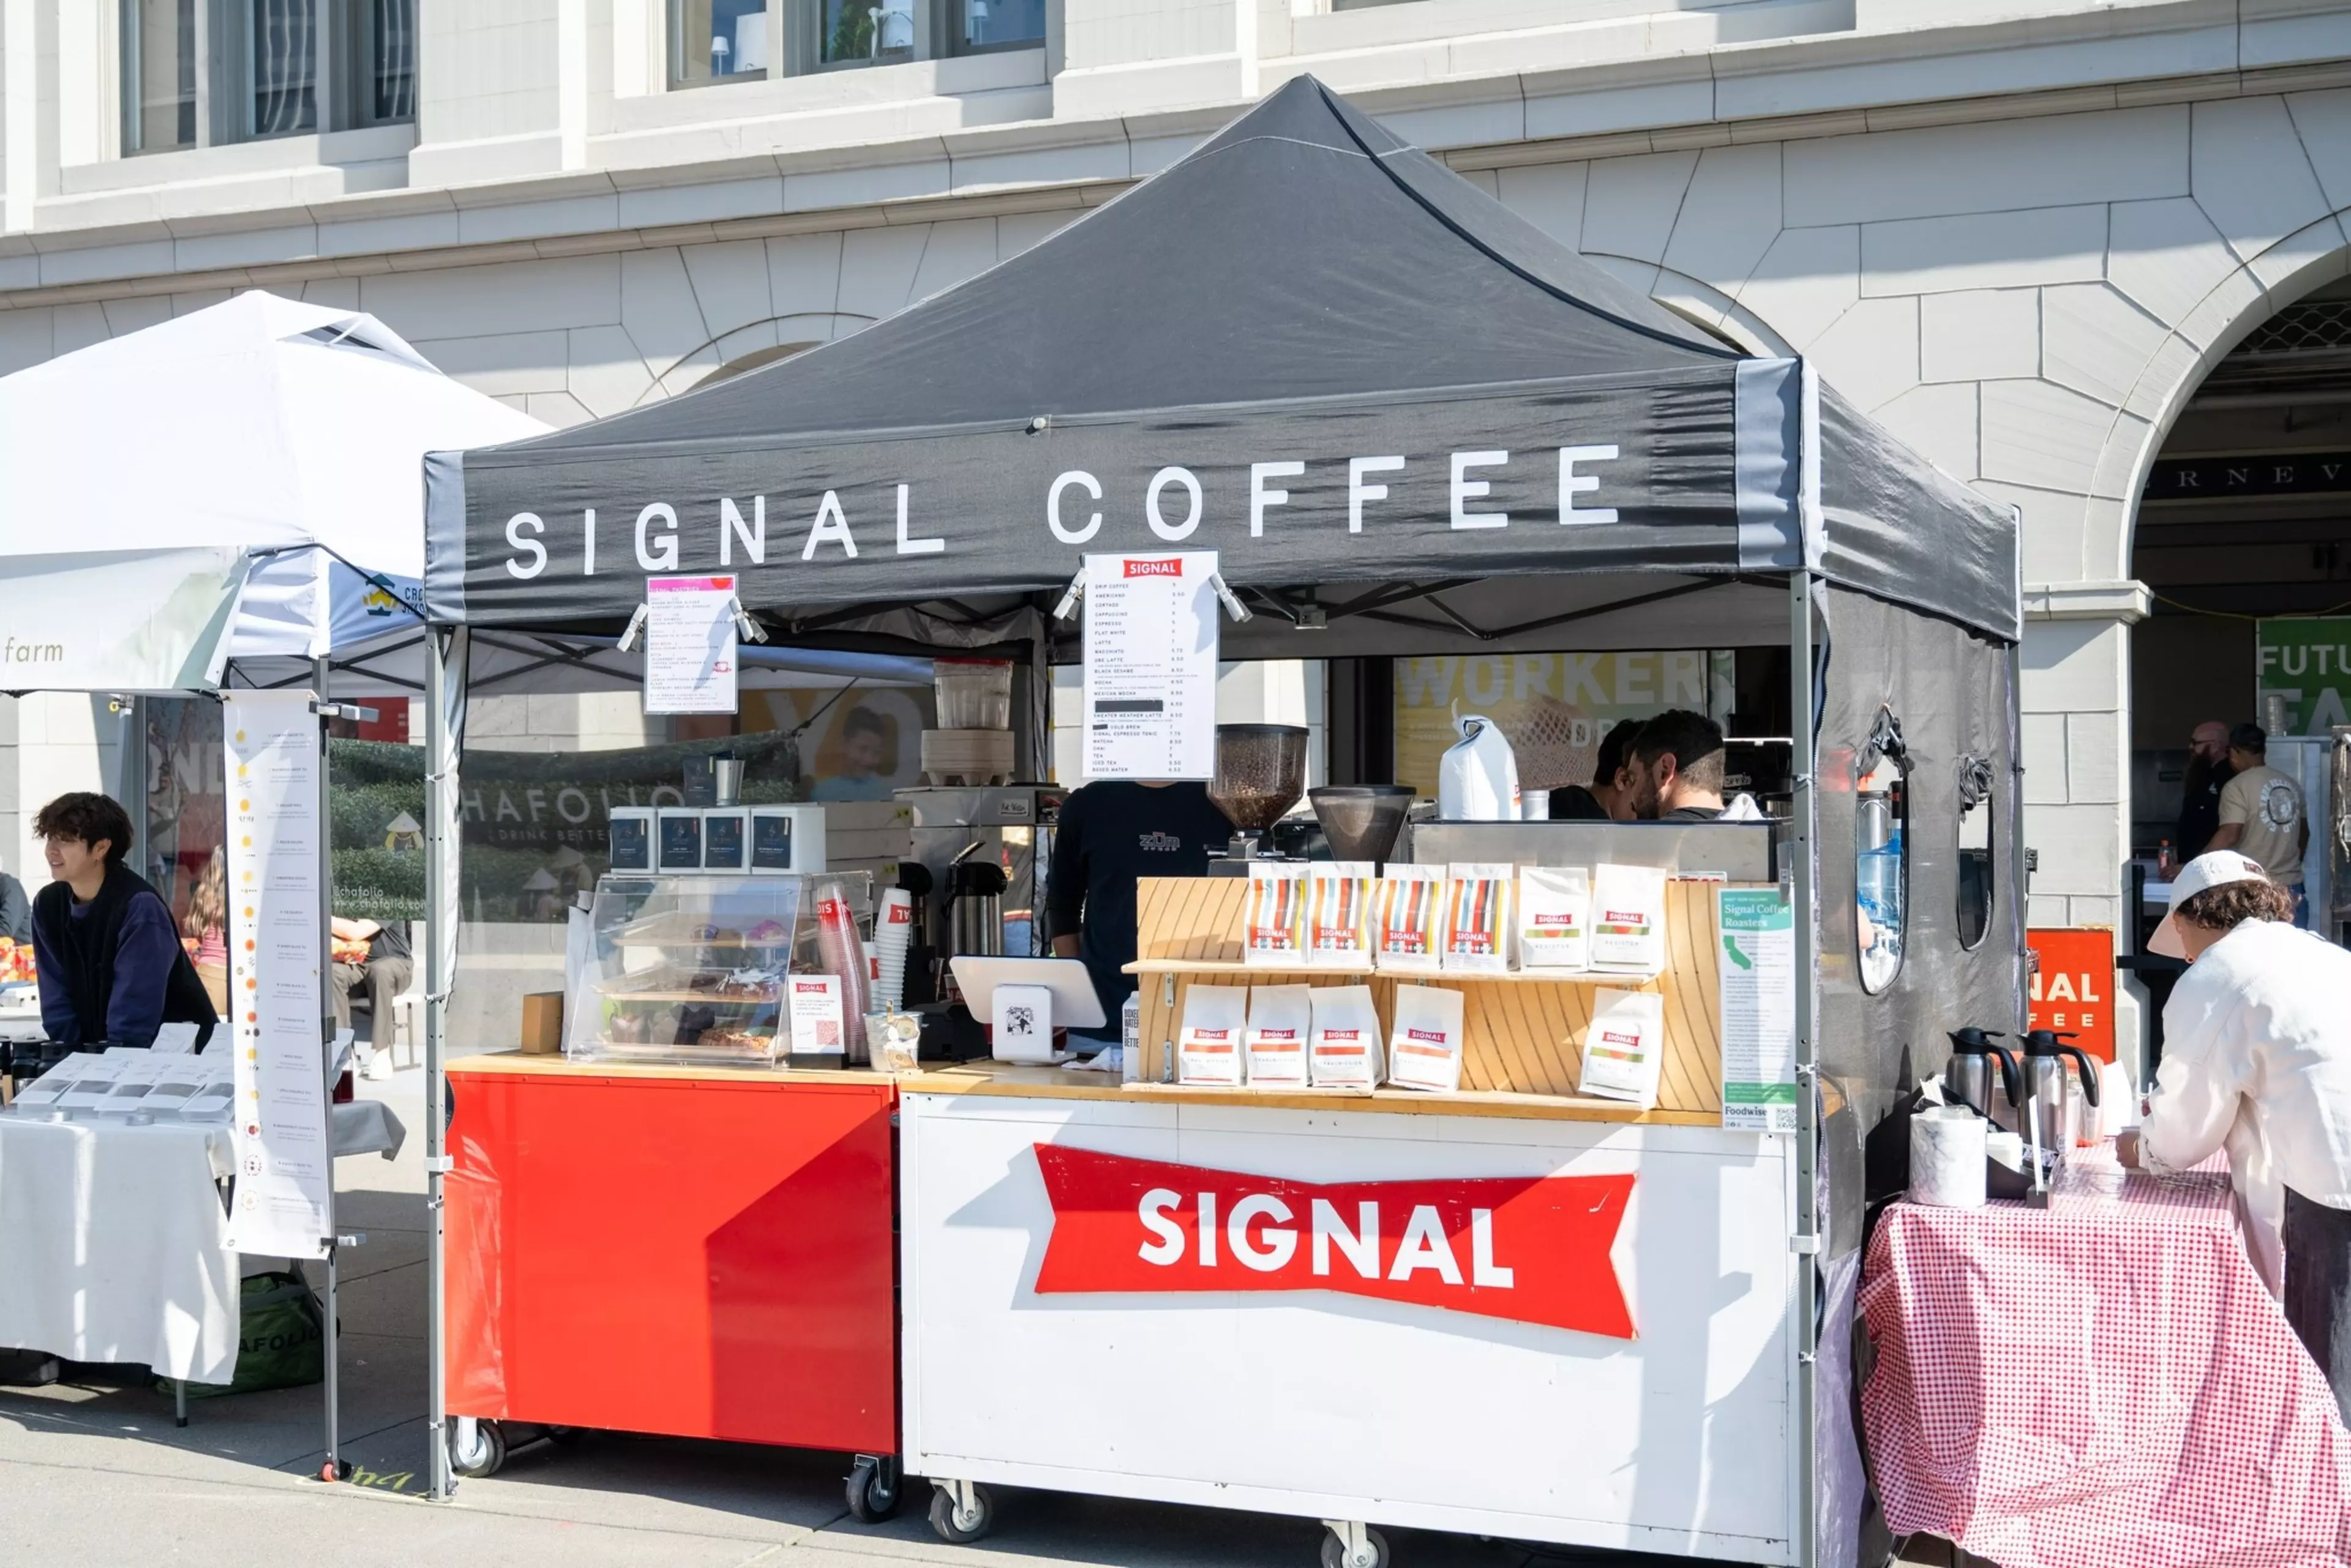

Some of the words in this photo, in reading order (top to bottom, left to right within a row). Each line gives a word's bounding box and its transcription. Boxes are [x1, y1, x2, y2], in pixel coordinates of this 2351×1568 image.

[2143, 463, 2343, 489] RNEV
[504, 484, 945, 580] SIGNAL
[1046, 444, 1619, 545] COFFEE
[1130, 560, 1176, 574] SIGNAL
[5, 637, 62, 662] farm
[1398, 651, 1707, 708] WORKER
[498, 829, 548, 841] DRINK
[558, 829, 611, 841] BETTE
[1725, 904, 1755, 916] Signal
[1757, 903, 1789, 914] Coffee
[1608, 913, 1640, 922] SIGNAL
[1725, 918, 1768, 928] Roasters
[1321, 929, 1352, 937] SIGNAL
[1389, 932, 1420, 941] SIGNAL
[1456, 932, 1488, 942] SIGNAL
[1412, 1032, 1442, 1041] SIGNAL
[1725, 1106, 1768, 1117] Foodwise
[1138, 1188, 1515, 1289] SIGNAL
